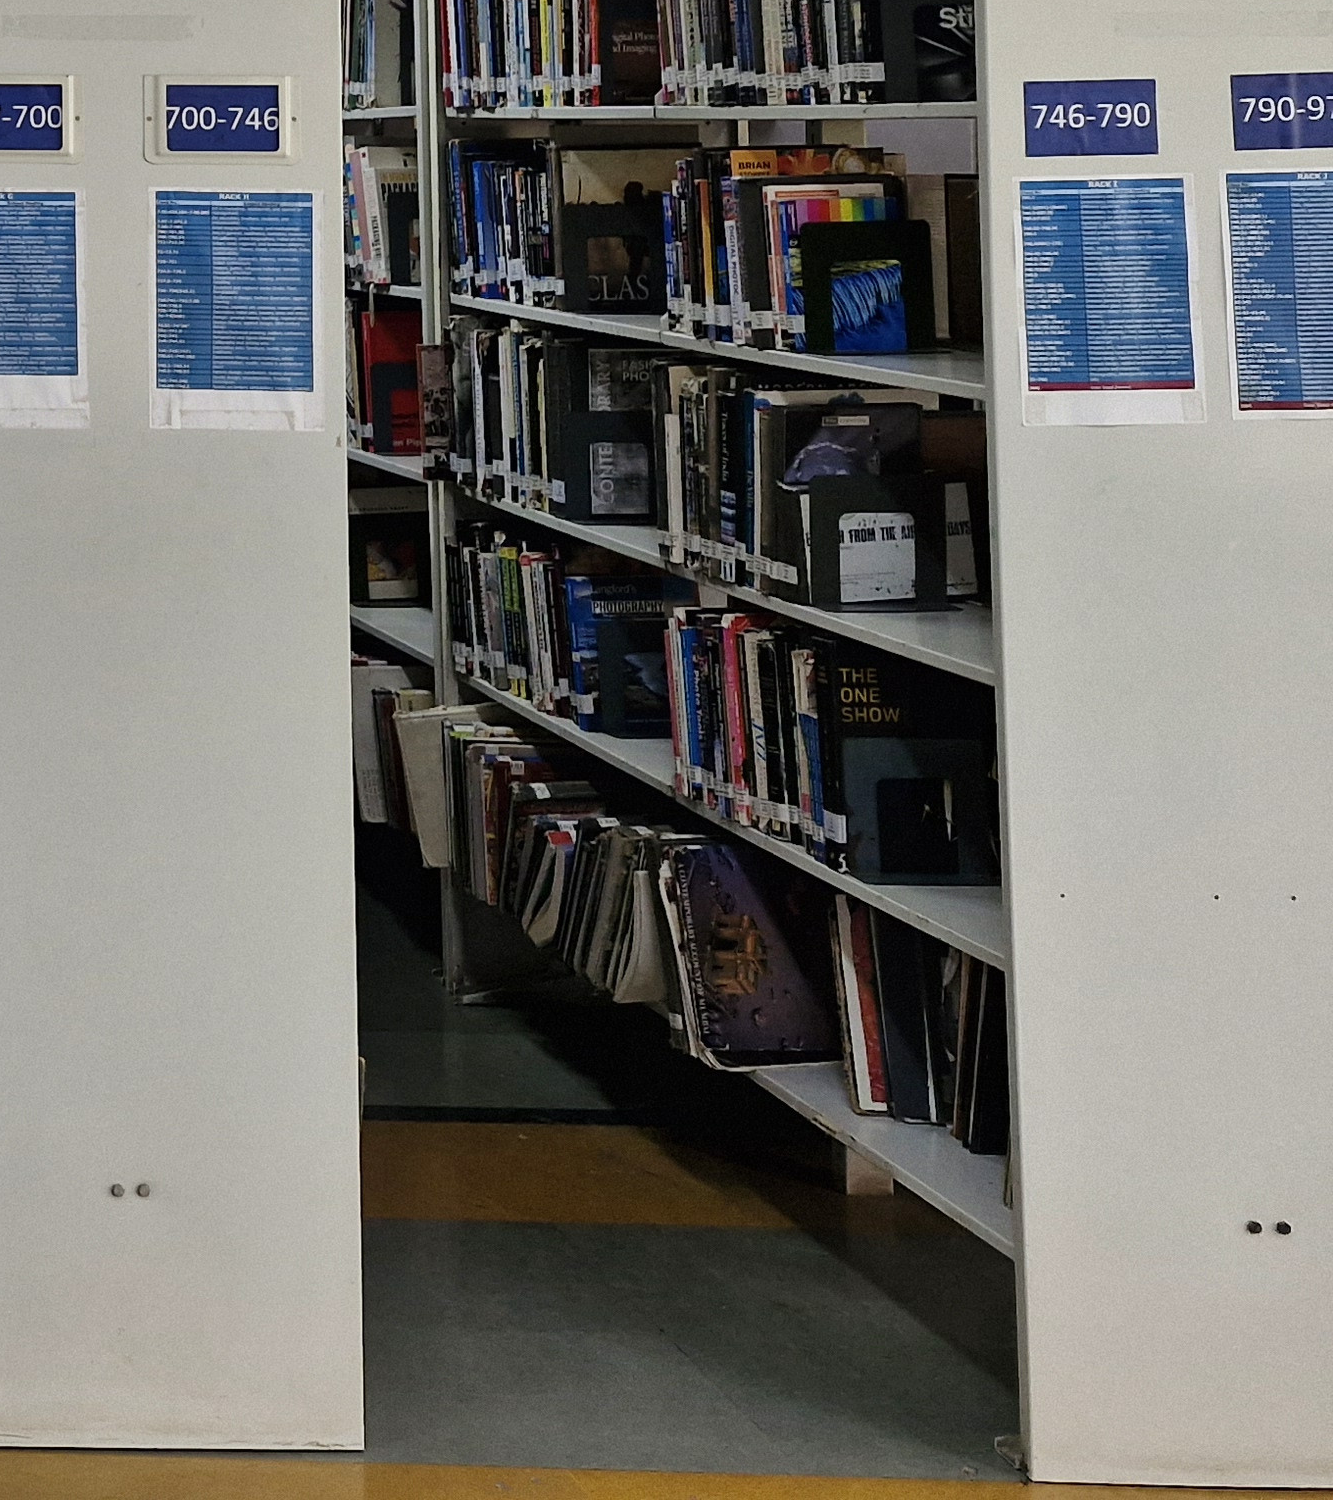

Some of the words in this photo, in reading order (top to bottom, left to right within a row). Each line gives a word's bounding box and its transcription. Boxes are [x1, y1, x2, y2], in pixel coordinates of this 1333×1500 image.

[165, 106, 279, 131] 700-746
[1029, 102, 1151, 129] 746-790
[738, 161, 771, 170] BRIAN
[1088, 180, 1111, 188] RACK
[848, 526, 876, 542] FROM
[592, 600, 664, 613] PHOTOGRAPHY
[838, 667, 878, 683] THE
[840, 687, 881, 703] ONE
[841, 707, 900, 723] SHOW
